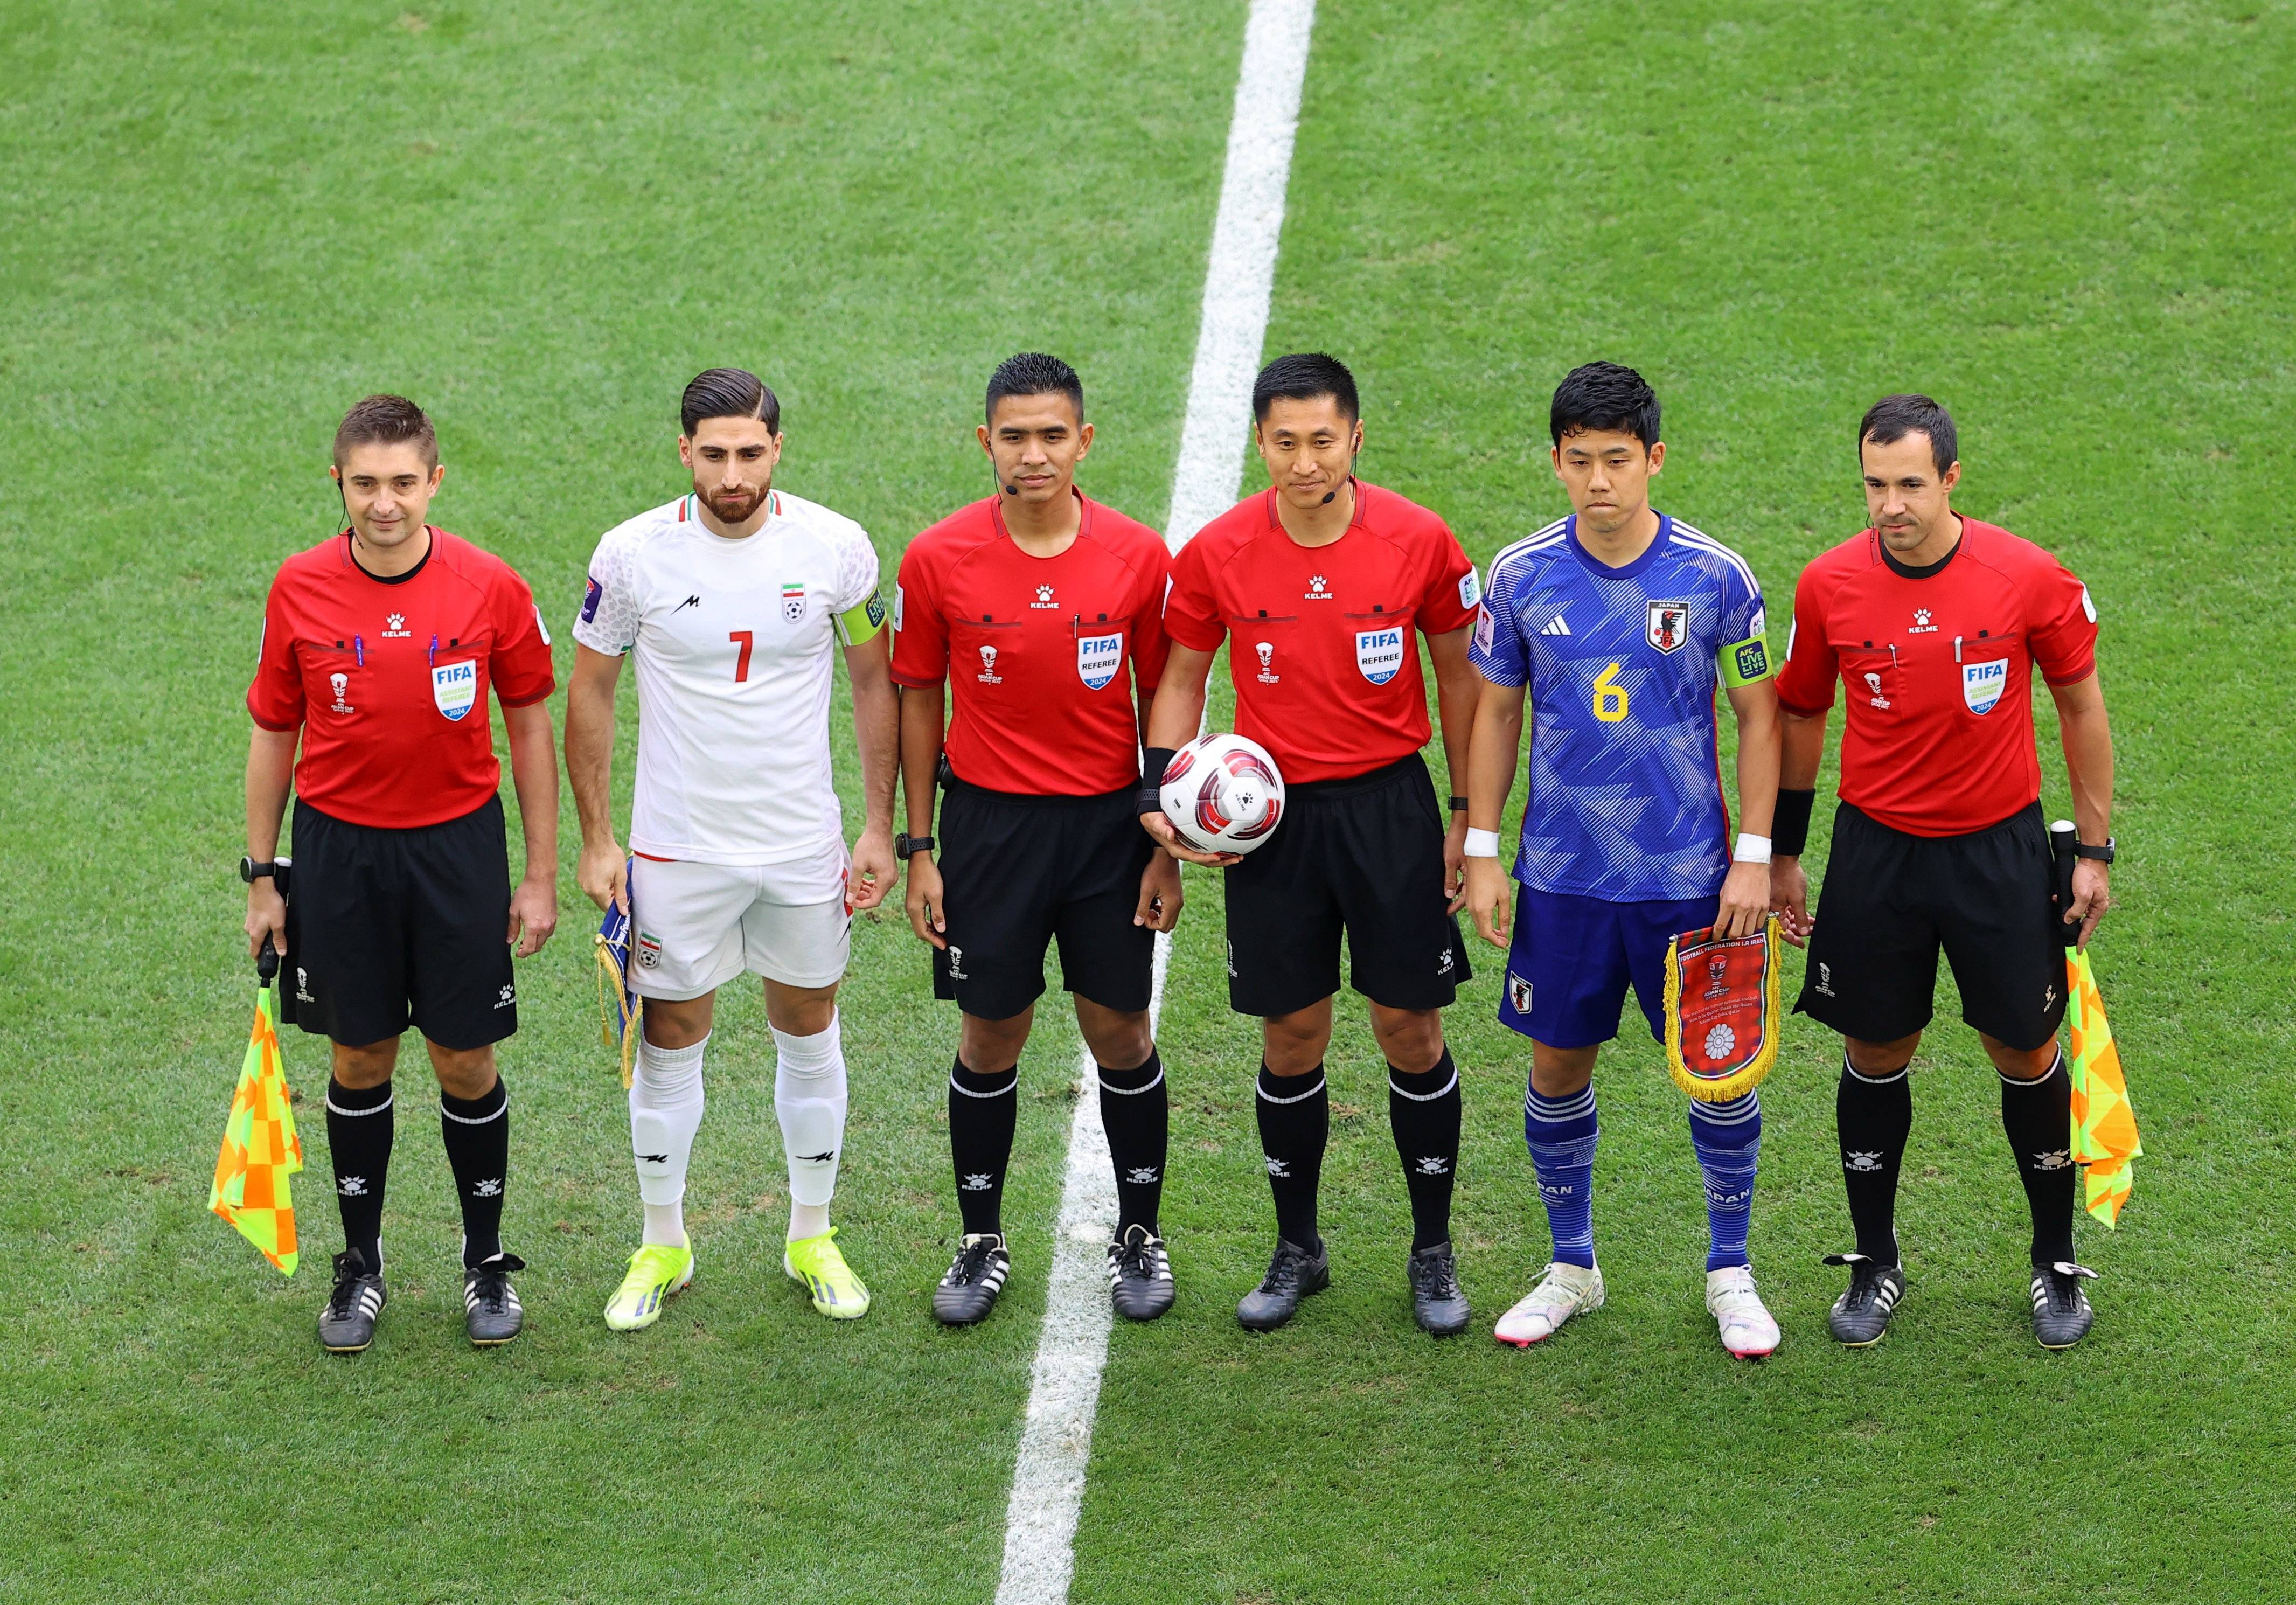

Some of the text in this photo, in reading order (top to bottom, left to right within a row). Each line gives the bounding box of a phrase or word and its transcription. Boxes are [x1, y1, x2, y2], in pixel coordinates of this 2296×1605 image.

[1908, 625, 1938, 633] KELME
[1083, 638, 1118, 655] FIFA
[1361, 632, 1399, 649] FIFA
[729, 630, 753, 683] 7
[1362, 652, 1400, 665] REFEREE
[1740, 647, 1754, 658] AFC
[1740, 650, 1764, 667] LIVE
[1082, 658, 1117, 670] REFEREE
[437, 666, 472, 685] FIFA
[1373, 672, 1390, 681] 2024
[1967, 664, 2003, 682] FIFA
[1090, 677, 1107, 686] 2024
[1968, 680, 2002, 694] ASSISTANT
[439, 685, 472, 697] ASSISTANT
[1594, 663, 1629, 722] 6
[1971, 689, 1998, 700] REFEREE
[442, 692, 471, 704] REFEREE
[448, 707, 465, 717] 2024
[1977, 702, 1992, 712] 2024
[1235, 794, 1246, 812] KELME
[1680, 949, 1704, 962] FOOTBALL
[1704, 941, 1741, 953] FEDERATION
[1437, 960, 1454, 975] KELM
[1704, 989, 1718, 997] ASIAN
[1416, 1166, 1449, 1175] KELME
[1845, 1161, 1883, 1172] KELME
[2033, 1159, 2072, 1170] KELME
[1126, 1176, 1158, 1184] KELME
[338, 1188, 368, 1196] KELME
[472, 1187, 502, 1197] KELME
[1536, 1180, 1573, 1194] PAN
